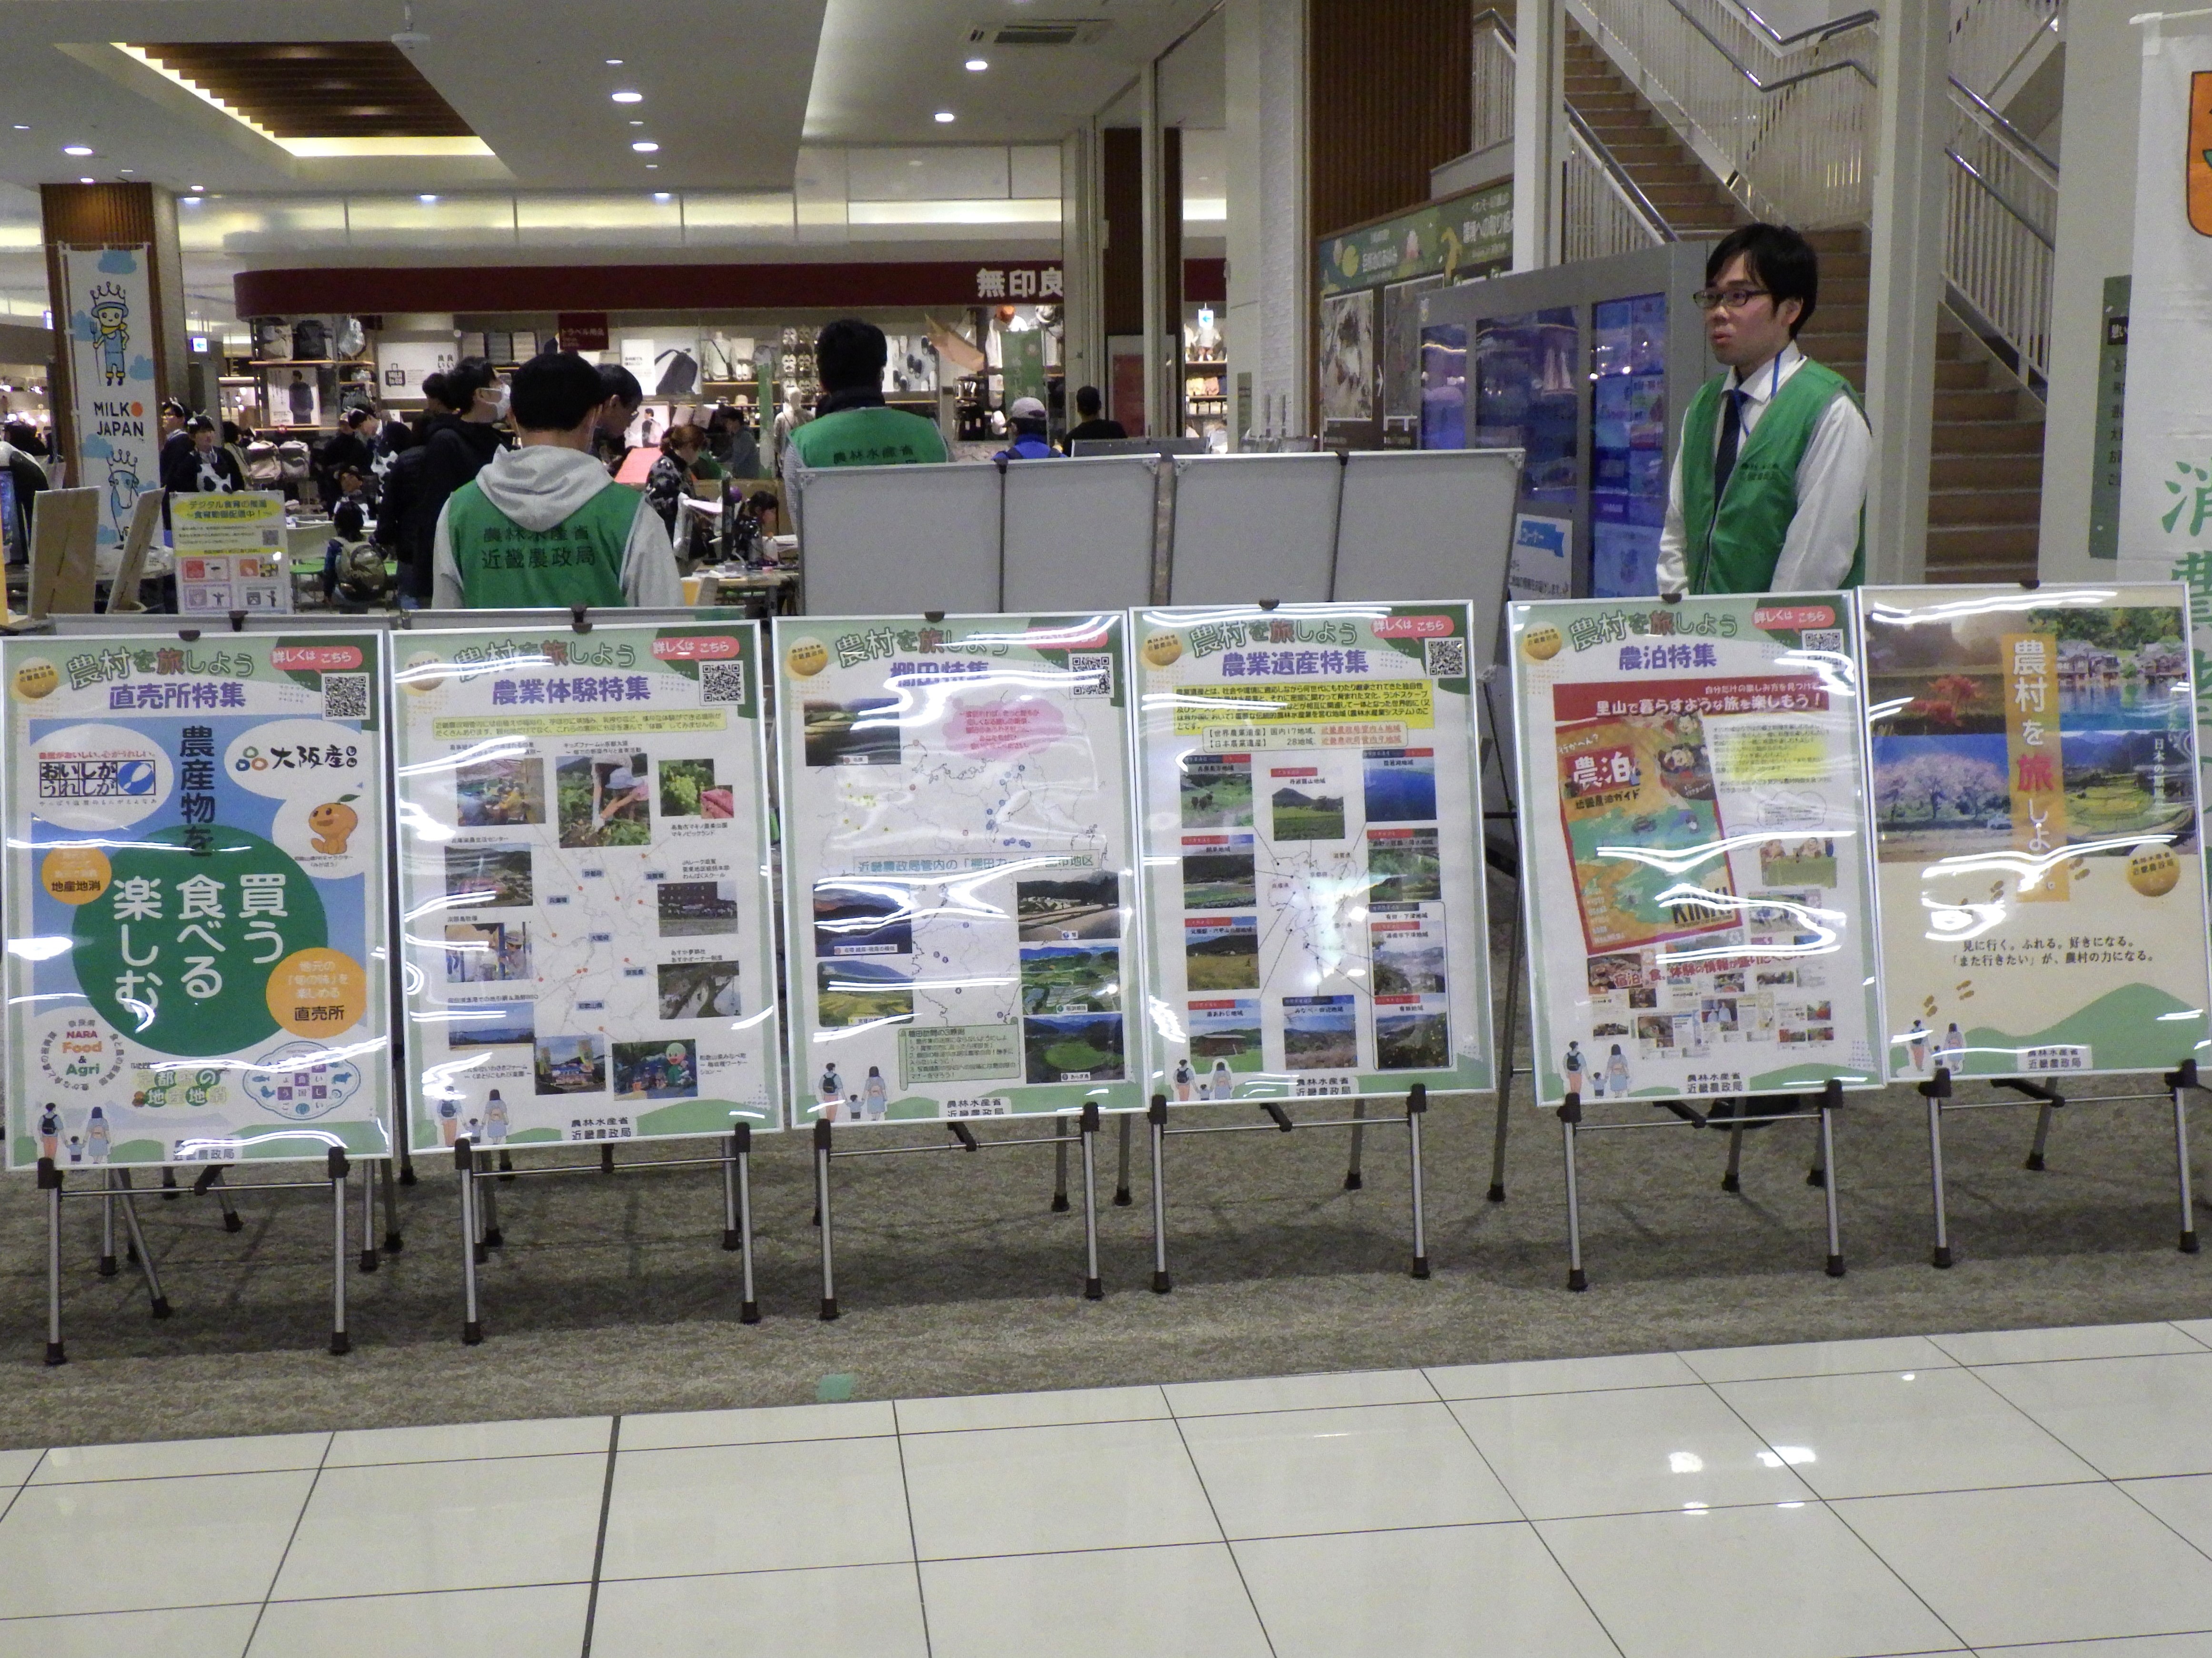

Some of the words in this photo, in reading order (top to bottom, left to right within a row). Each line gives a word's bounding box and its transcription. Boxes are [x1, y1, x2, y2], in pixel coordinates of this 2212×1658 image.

[95, 401, 129, 417] MILK
[97, 421, 144, 437] JAPAN
[482, 546, 597, 570] 近畿農政局
[1754, 609, 1794, 624] 詳しくは
[1798, 610, 1826, 623] こちら
[1372, 618, 1413, 633] 詳しくは
[1417, 619, 1445, 632] こちら
[1570, 610, 1738, 652] 農村を旅しよう
[1190, 617, 1357, 658] 農村を旅しよう
[652, 639, 695, 654] 詳しくは
[700, 640, 729, 653] こちら
[271, 648, 316, 663] 詳しくは
[321, 650, 352, 663] こちら
[455, 638, 637, 681] 農村を旅しよう
[1222, 649, 1369, 678] 農業遺産特集
[1618, 642, 1717, 671] 農泊特集
[67, 646, 255, 690] 農村を旅しよう
[110, 682, 246, 710] 直売所特集
[492, 676, 651, 705] 農業体験特集
[1595, 693, 1820, 717] 里山で暮らすような旅を楽しもう！
[1209, 727, 1266, 739] 【世界農業遺産】
[1209, 739, 1266, 750] 【日本農業遺産】
[1573, 751, 1632, 791] 農泊
[180, 725, 215, 857] 農産物を
[52, 880, 101, 892] 地産地消
[239, 874, 288, 964] 買う
[113, 875, 163, 1015] 楽しむ
[176, 874, 226, 999] 食べる
[1963, 935, 2135, 953] 見に行く。ふれる。好きになる。
[294, 1005, 345, 1021] 直売所
[66, 1030, 98, 1039] NARA
[62, 1041, 102, 1054] Food
[78, 1055, 87, 1064] &
[66, 1063, 100, 1077] Agri
[571, 1117, 628, 1127] 農林水産省
[571, 1127, 632, 1141] 近畿農政局
